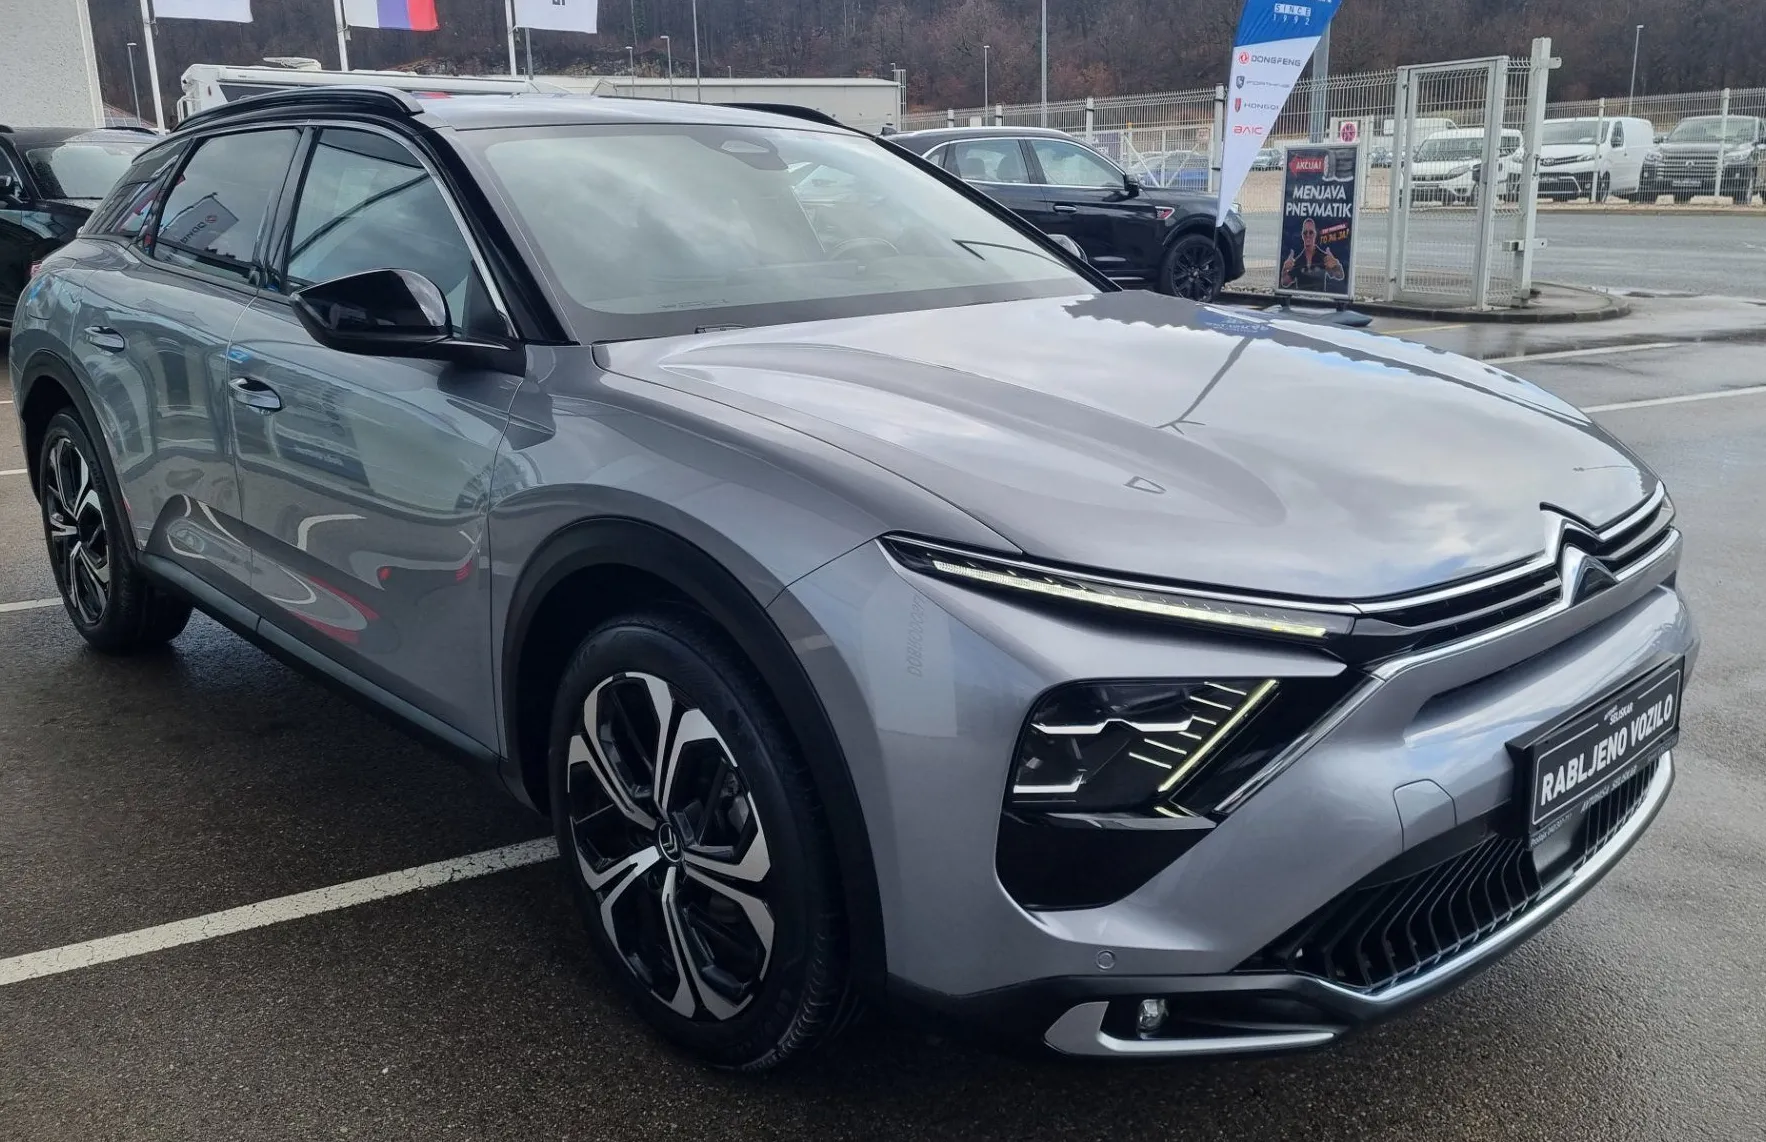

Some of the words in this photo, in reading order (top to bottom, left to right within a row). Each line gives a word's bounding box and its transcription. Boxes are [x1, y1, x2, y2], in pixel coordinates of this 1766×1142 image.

[1275, 4, 1310, 16] SINCE
[1273, 14, 1310, 25] 1992
[1251, 54, 1301, 67] DONGFENG
[1244, 102, 1280, 110] HONGQI
[1292, 184, 1346, 200] MENJAVA
[1286, 202, 1352, 218] PNEVMATIK
[1540, 727, 1628, 806] RABLJENO
[1630, 693, 1673, 747] VOZILO
